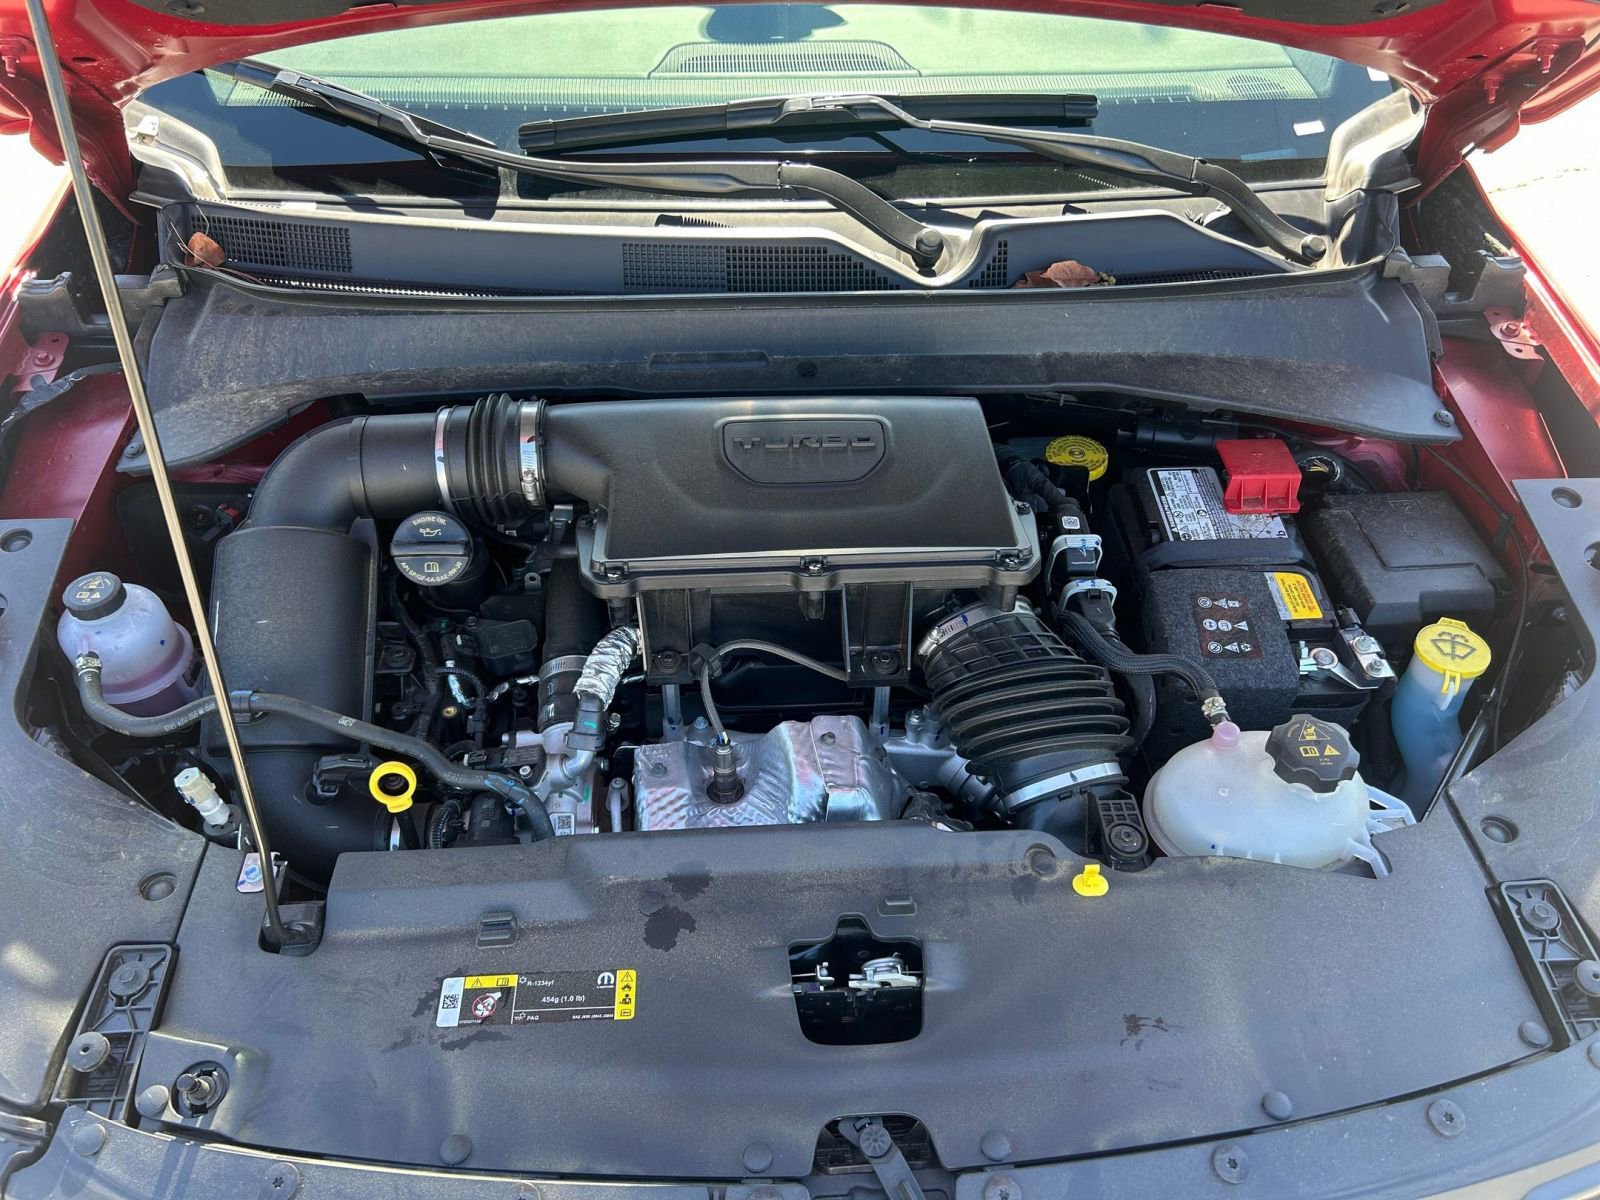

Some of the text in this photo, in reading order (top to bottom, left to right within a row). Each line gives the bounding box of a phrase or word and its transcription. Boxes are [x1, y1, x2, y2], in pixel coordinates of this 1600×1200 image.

[732, 434, 877, 450] TURBO
[413, 516, 447, 526] ENGINE OIL
[400, 562, 410, 571] API
[542, 995, 585, 1004] 454g (1.0 lb)
